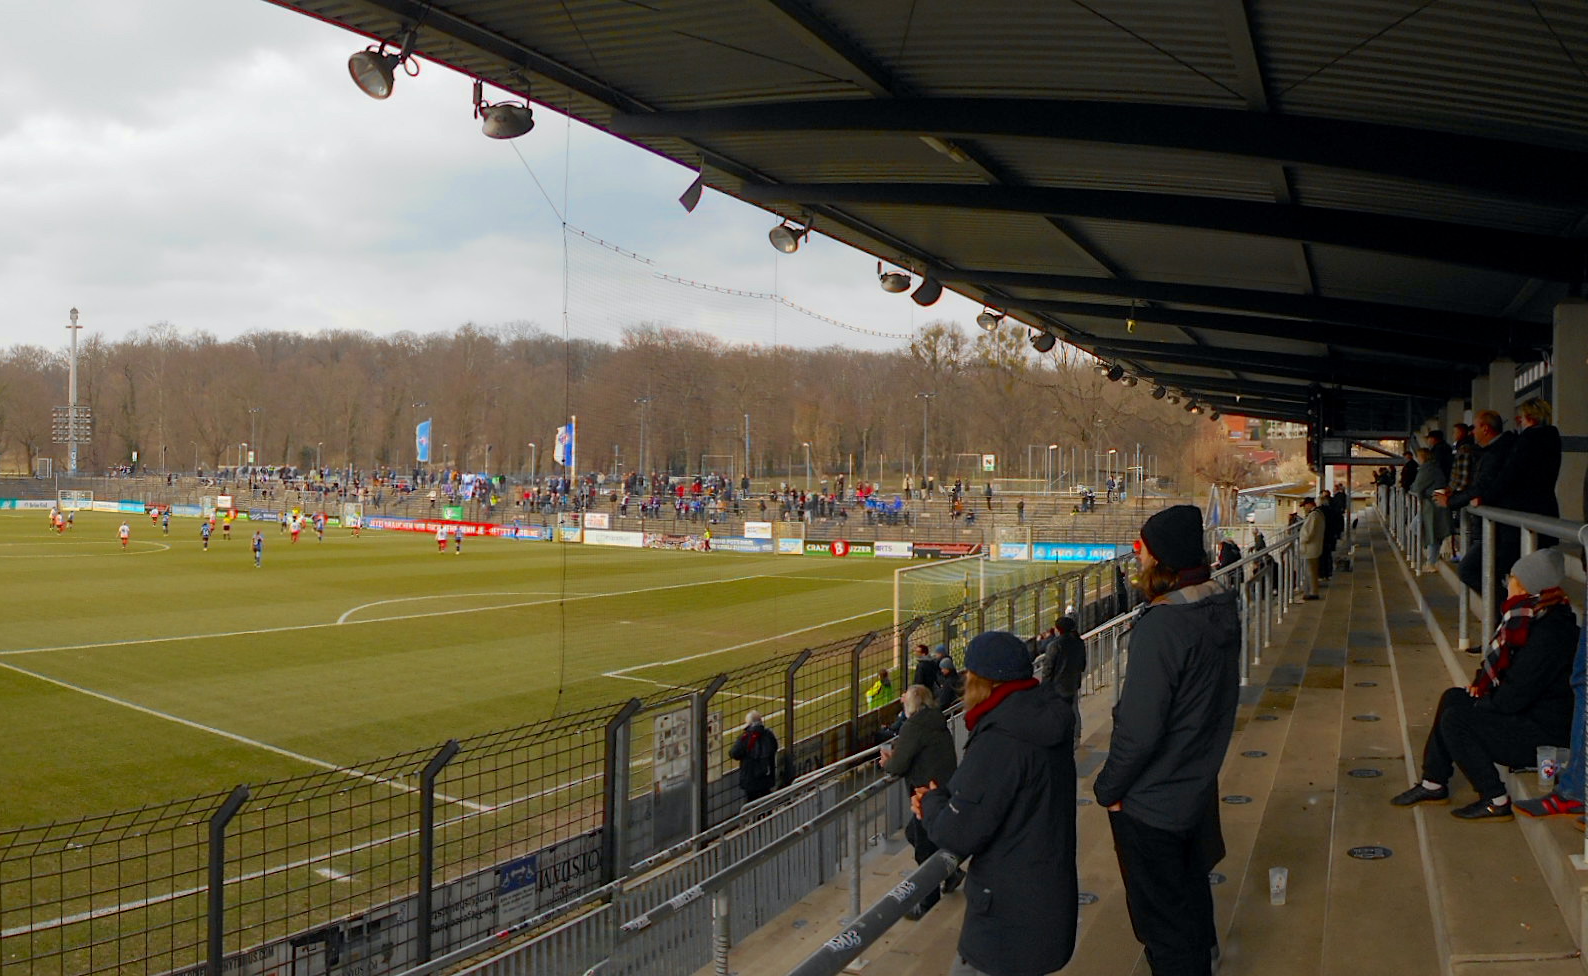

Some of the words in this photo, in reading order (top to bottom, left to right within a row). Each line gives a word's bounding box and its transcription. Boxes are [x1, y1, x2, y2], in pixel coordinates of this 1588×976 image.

[806, 543, 830, 552] CRAZY
[539, 850, 602, 892] OTSDAM
[823, 929, 862, 951] 1903
